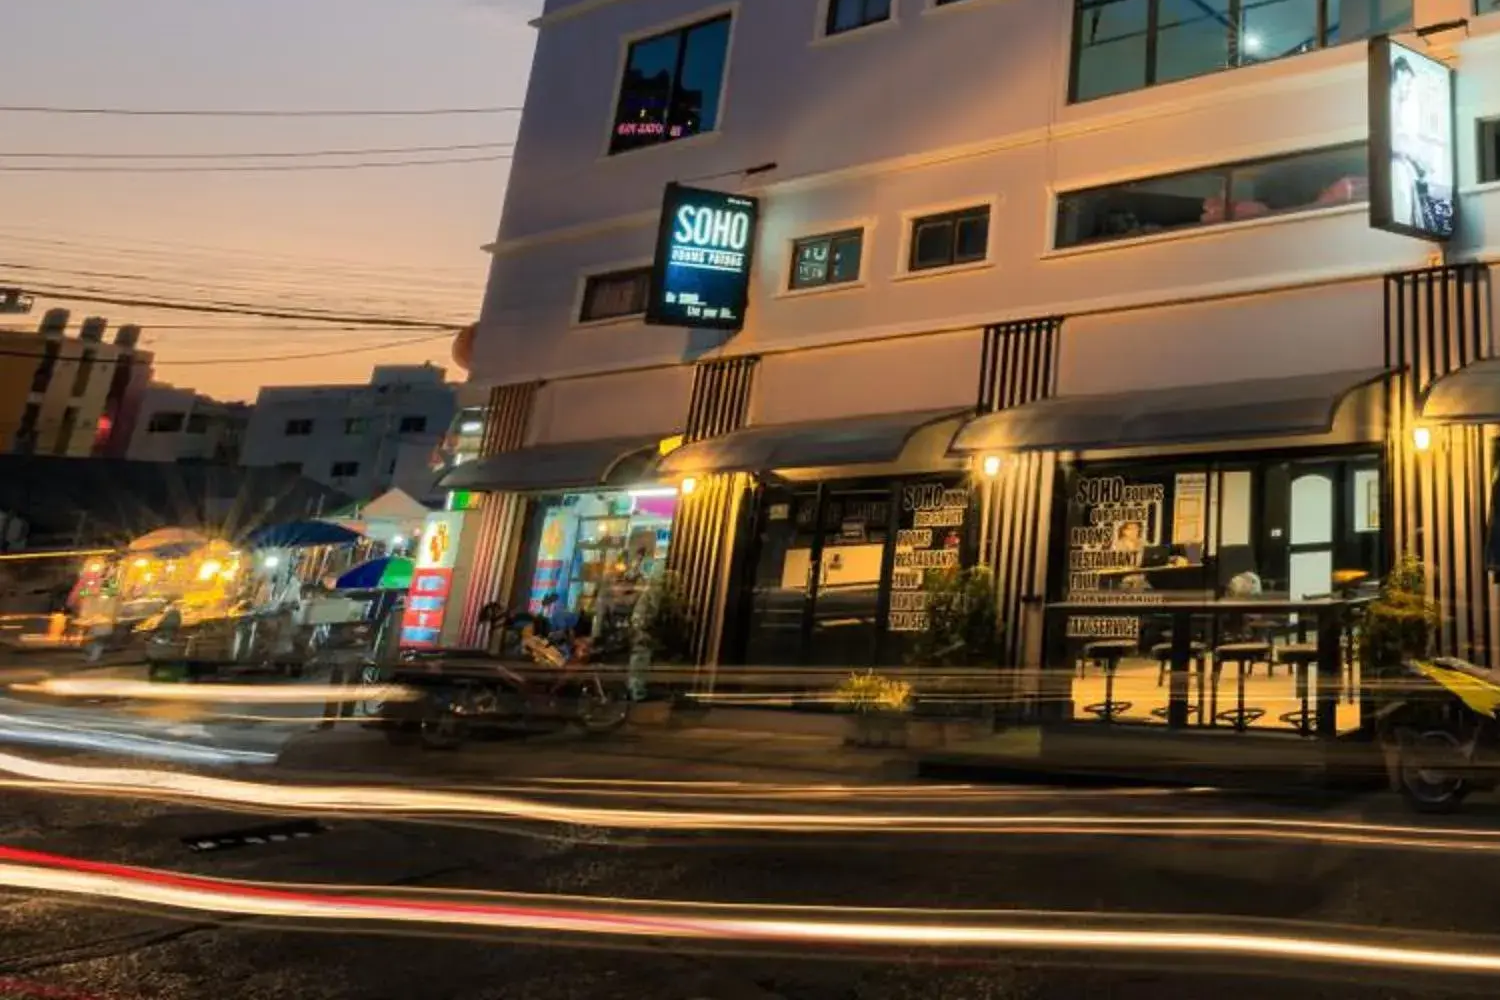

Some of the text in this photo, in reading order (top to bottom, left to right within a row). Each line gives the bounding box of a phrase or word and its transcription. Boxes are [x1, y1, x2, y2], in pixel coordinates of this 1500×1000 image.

[674, 204, 749, 250] SOHO
[904, 485, 943, 510] SOHO
[1076, 477, 1163, 504] SOHO ROOMS
[896, 530, 932, 548] ROOMS
[1072, 527, 1112, 546] ROOMS
[1070, 549, 1138, 568] RESTAURANT
[1094, 616, 1138, 636] SERVICE
